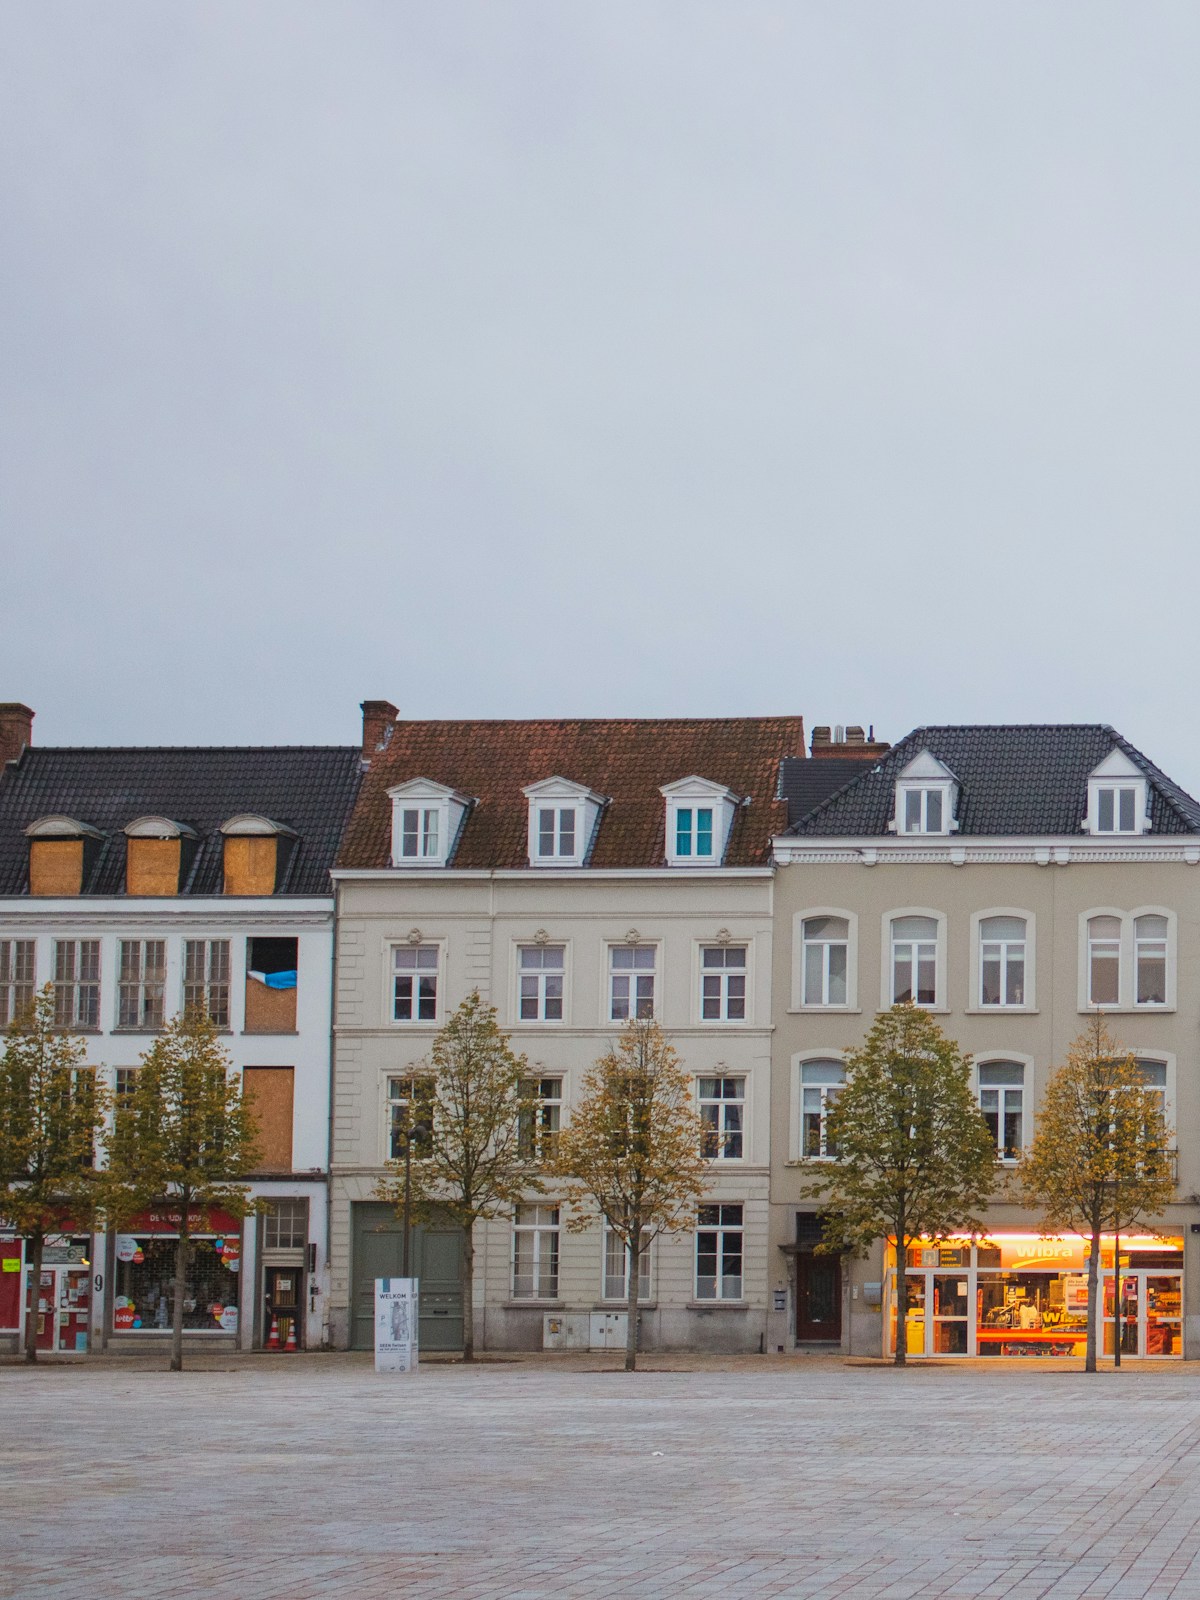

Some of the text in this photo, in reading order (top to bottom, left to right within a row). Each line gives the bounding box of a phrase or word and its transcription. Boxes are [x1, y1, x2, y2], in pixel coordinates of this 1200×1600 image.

[1016, 1246, 1072, 1258] Wibra
[95, 1274, 102, 1291] 9
[1042, 1310, 1088, 1322] Wibra
